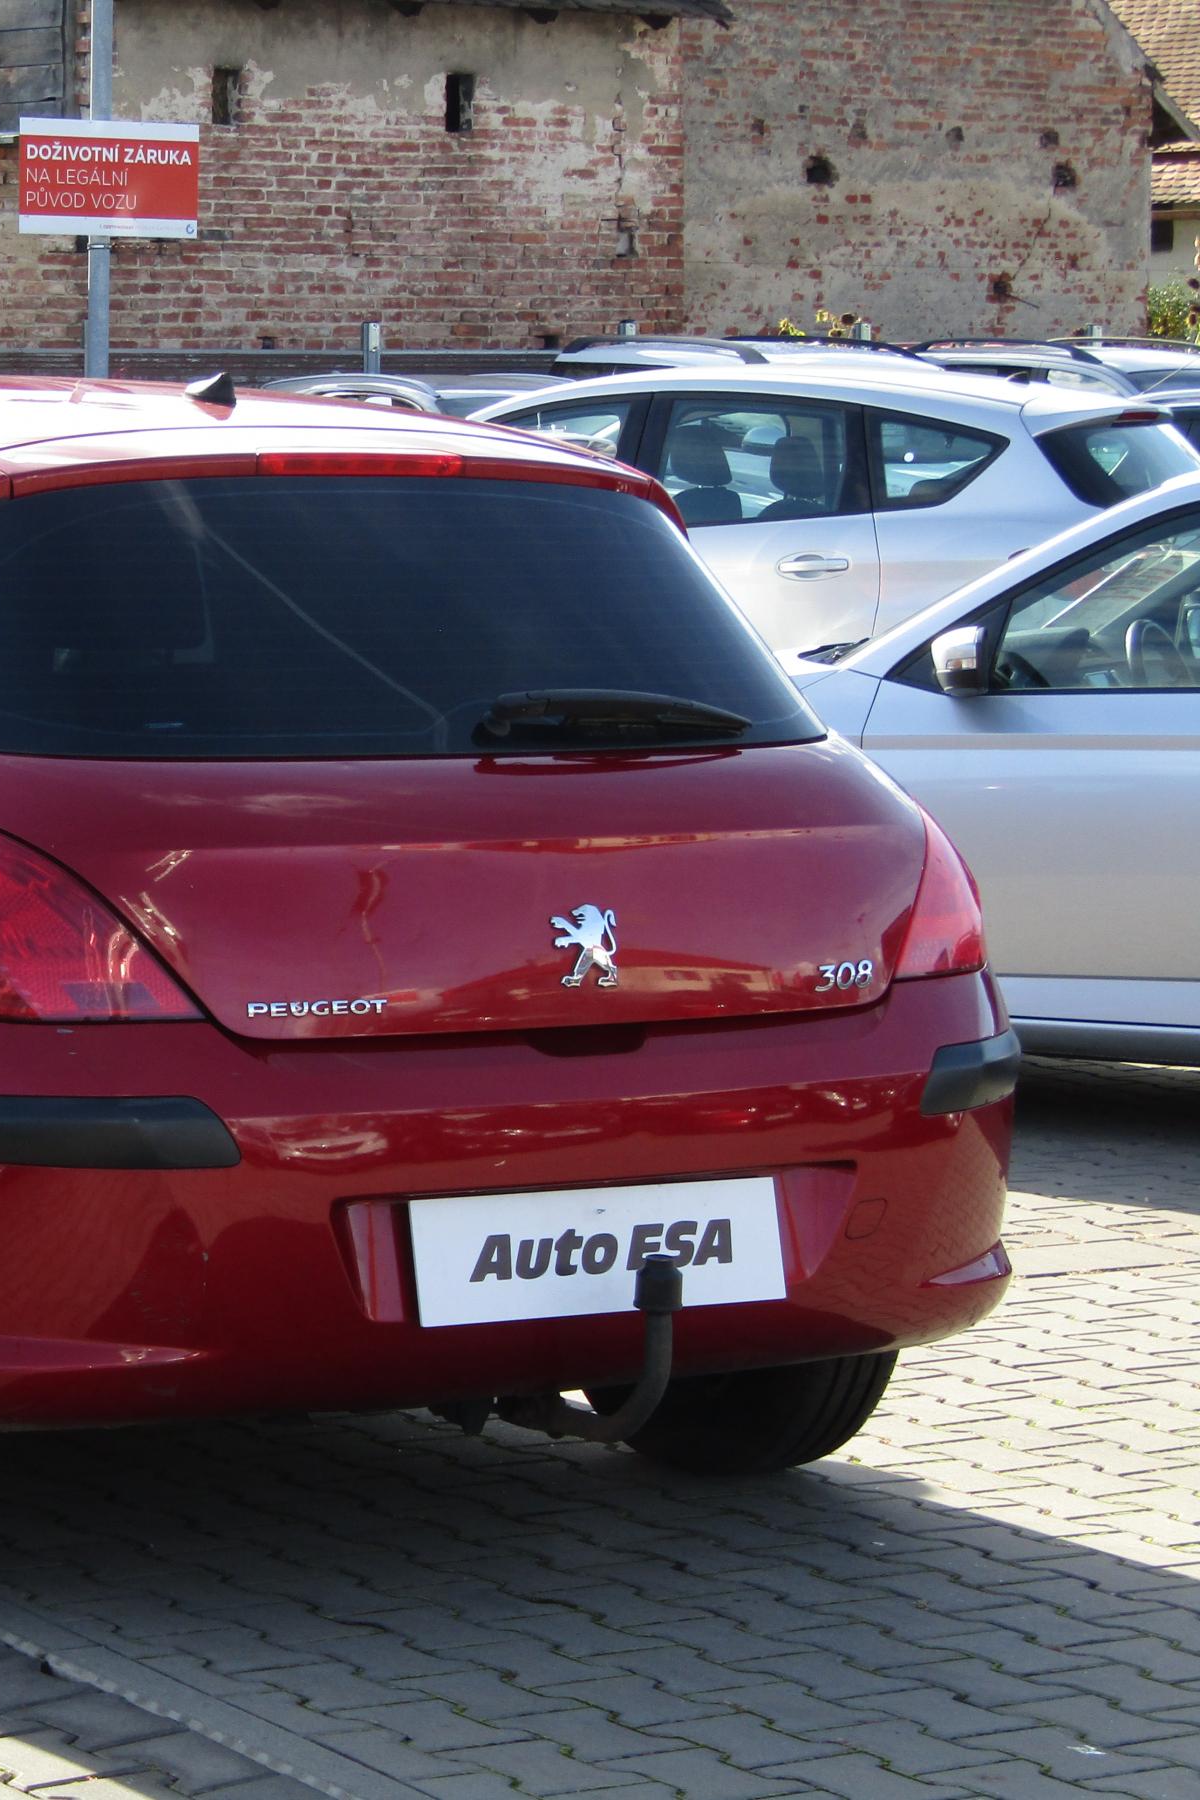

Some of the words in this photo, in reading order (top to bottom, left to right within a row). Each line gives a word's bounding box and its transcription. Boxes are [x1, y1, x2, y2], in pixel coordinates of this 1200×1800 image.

[26, 141, 120, 163] DOŽIVOTNÍ
[123, 145, 192, 165] ZÁRUKA
[26, 168, 51, 184] NA
[56, 167, 128, 186] LEGÁLNÍ
[26, 187, 86, 209] PŮVOD
[90, 193, 138, 210] VOZU
[814, 959, 875, 994] 308
[246, 997, 388, 1019] PEUGEOT
[469, 1228, 619, 1282] Auto
[626, 1218, 733, 1271] ESA
